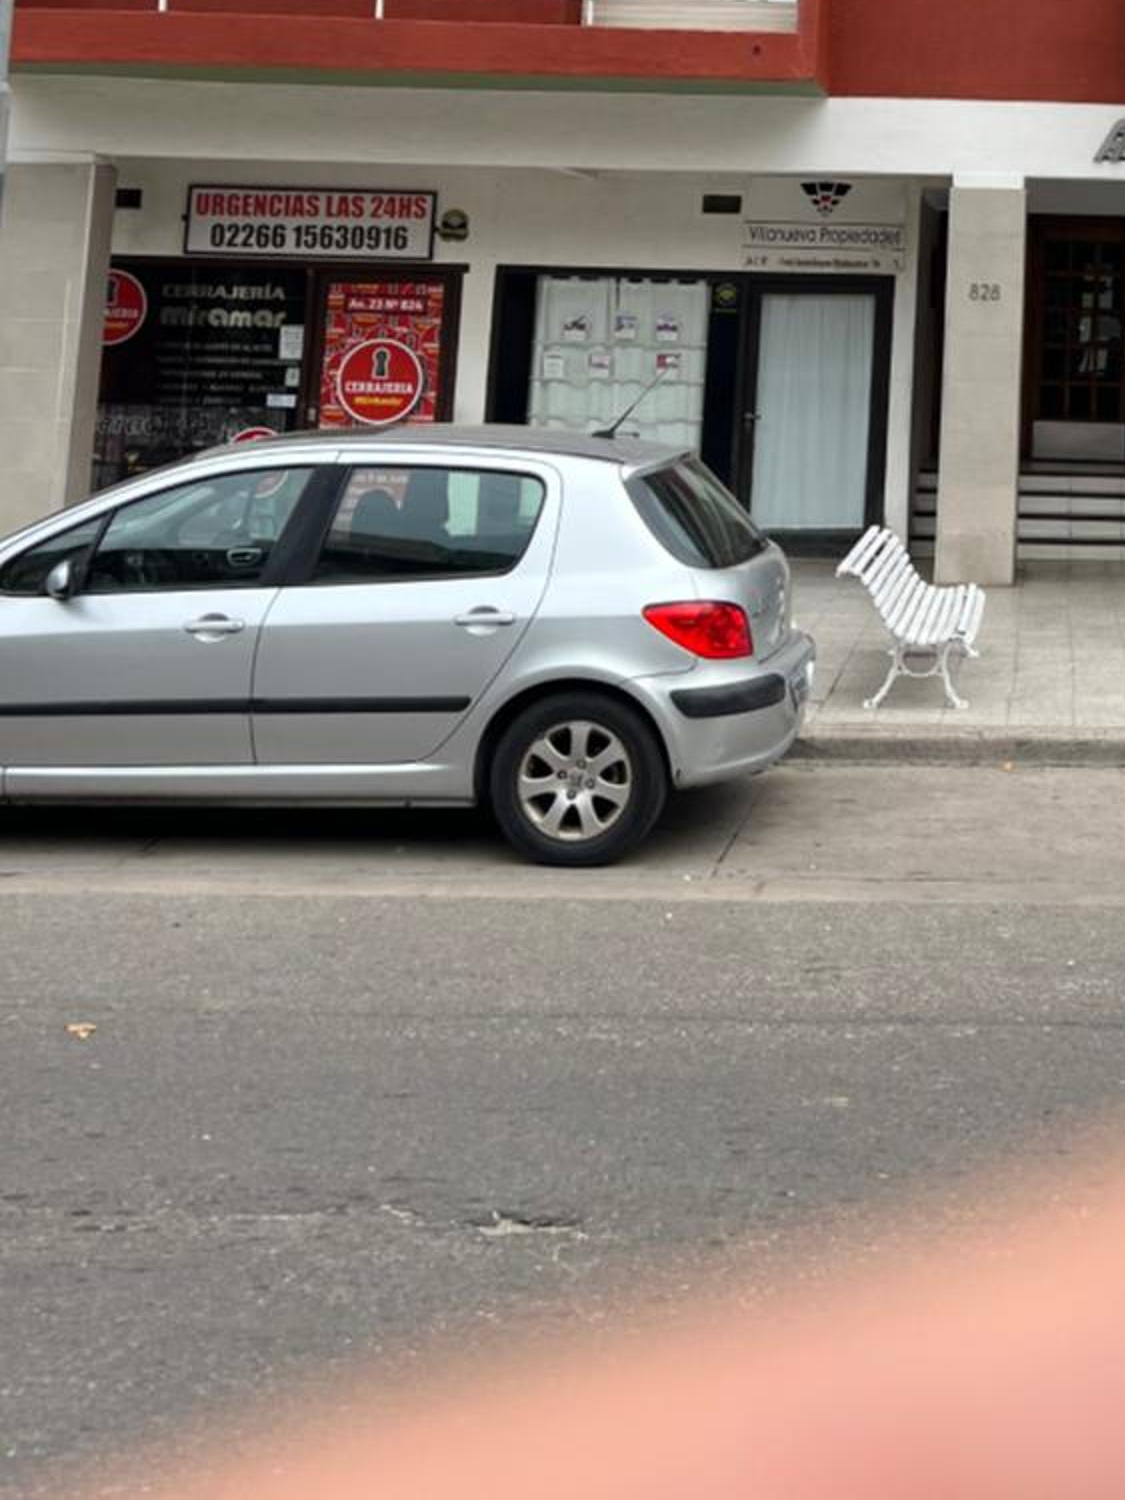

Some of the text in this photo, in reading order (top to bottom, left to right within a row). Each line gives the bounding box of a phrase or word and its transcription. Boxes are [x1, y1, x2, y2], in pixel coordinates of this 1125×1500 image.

[195, 192, 427, 219] URGENCIAS LAS 24HS
[210, 223, 408, 250] 02266 15630916
[969, 283, 1001, 301] 828
